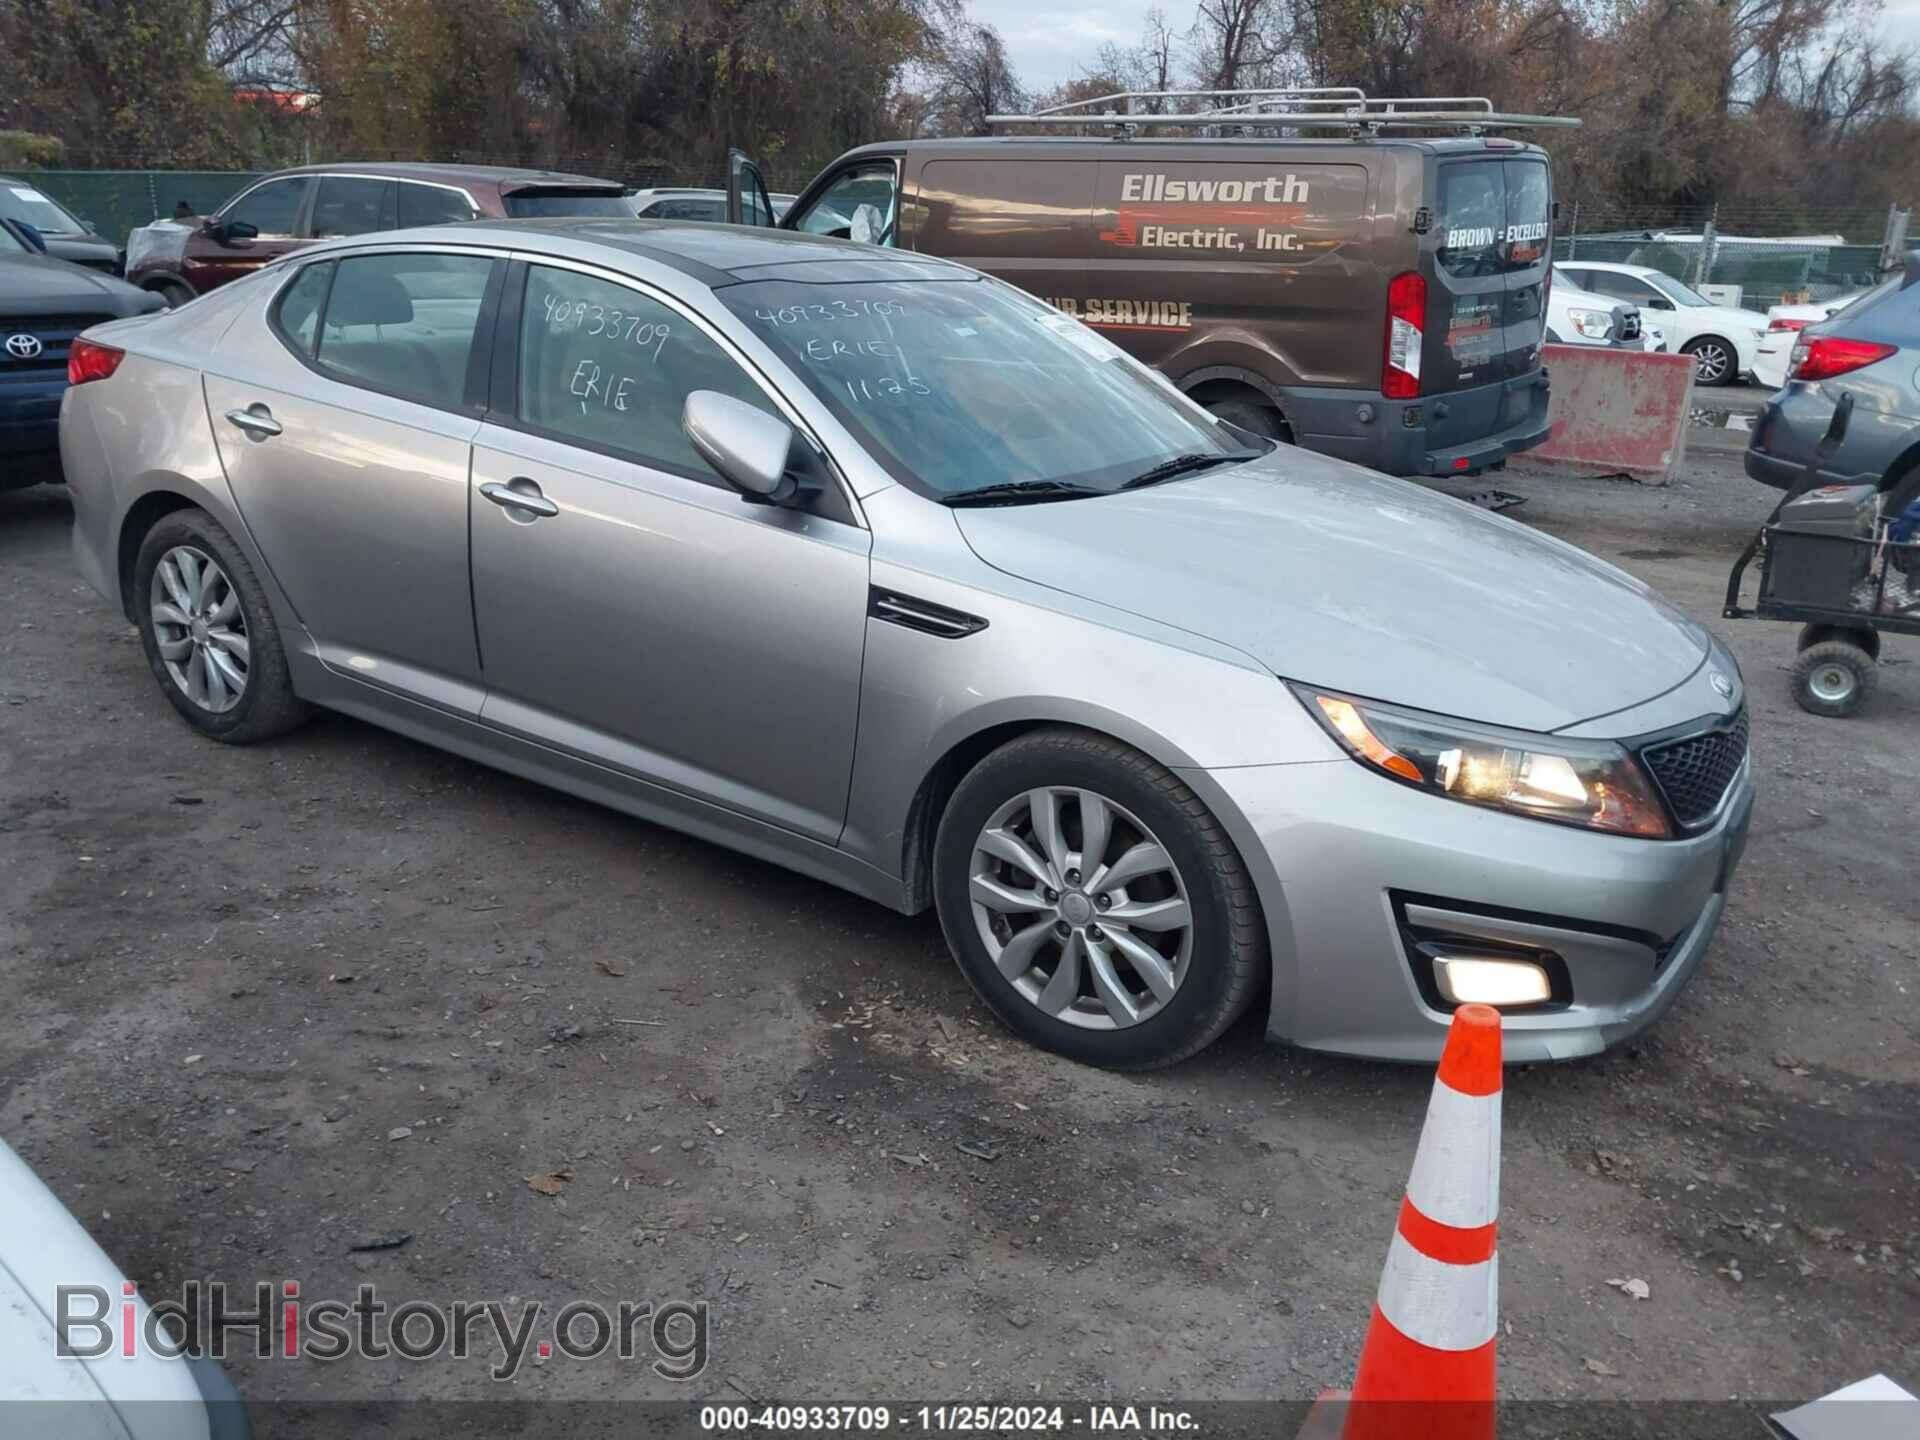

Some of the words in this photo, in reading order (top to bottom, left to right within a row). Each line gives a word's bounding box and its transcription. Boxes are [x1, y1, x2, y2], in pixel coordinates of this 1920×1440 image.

[1121, 174, 1310, 203] Ellsworth
[1141, 226, 1246, 253] Electric,
[1255, 228, 1305, 251] Inc.
[1447, 227, 1495, 248] BROWN
[1086, 299, 1192, 327] SERVICE
[544, 293, 671, 365] 40933709
[570, 360, 636, 412] ERIE
[846, 377, 931, 402] 11.25
